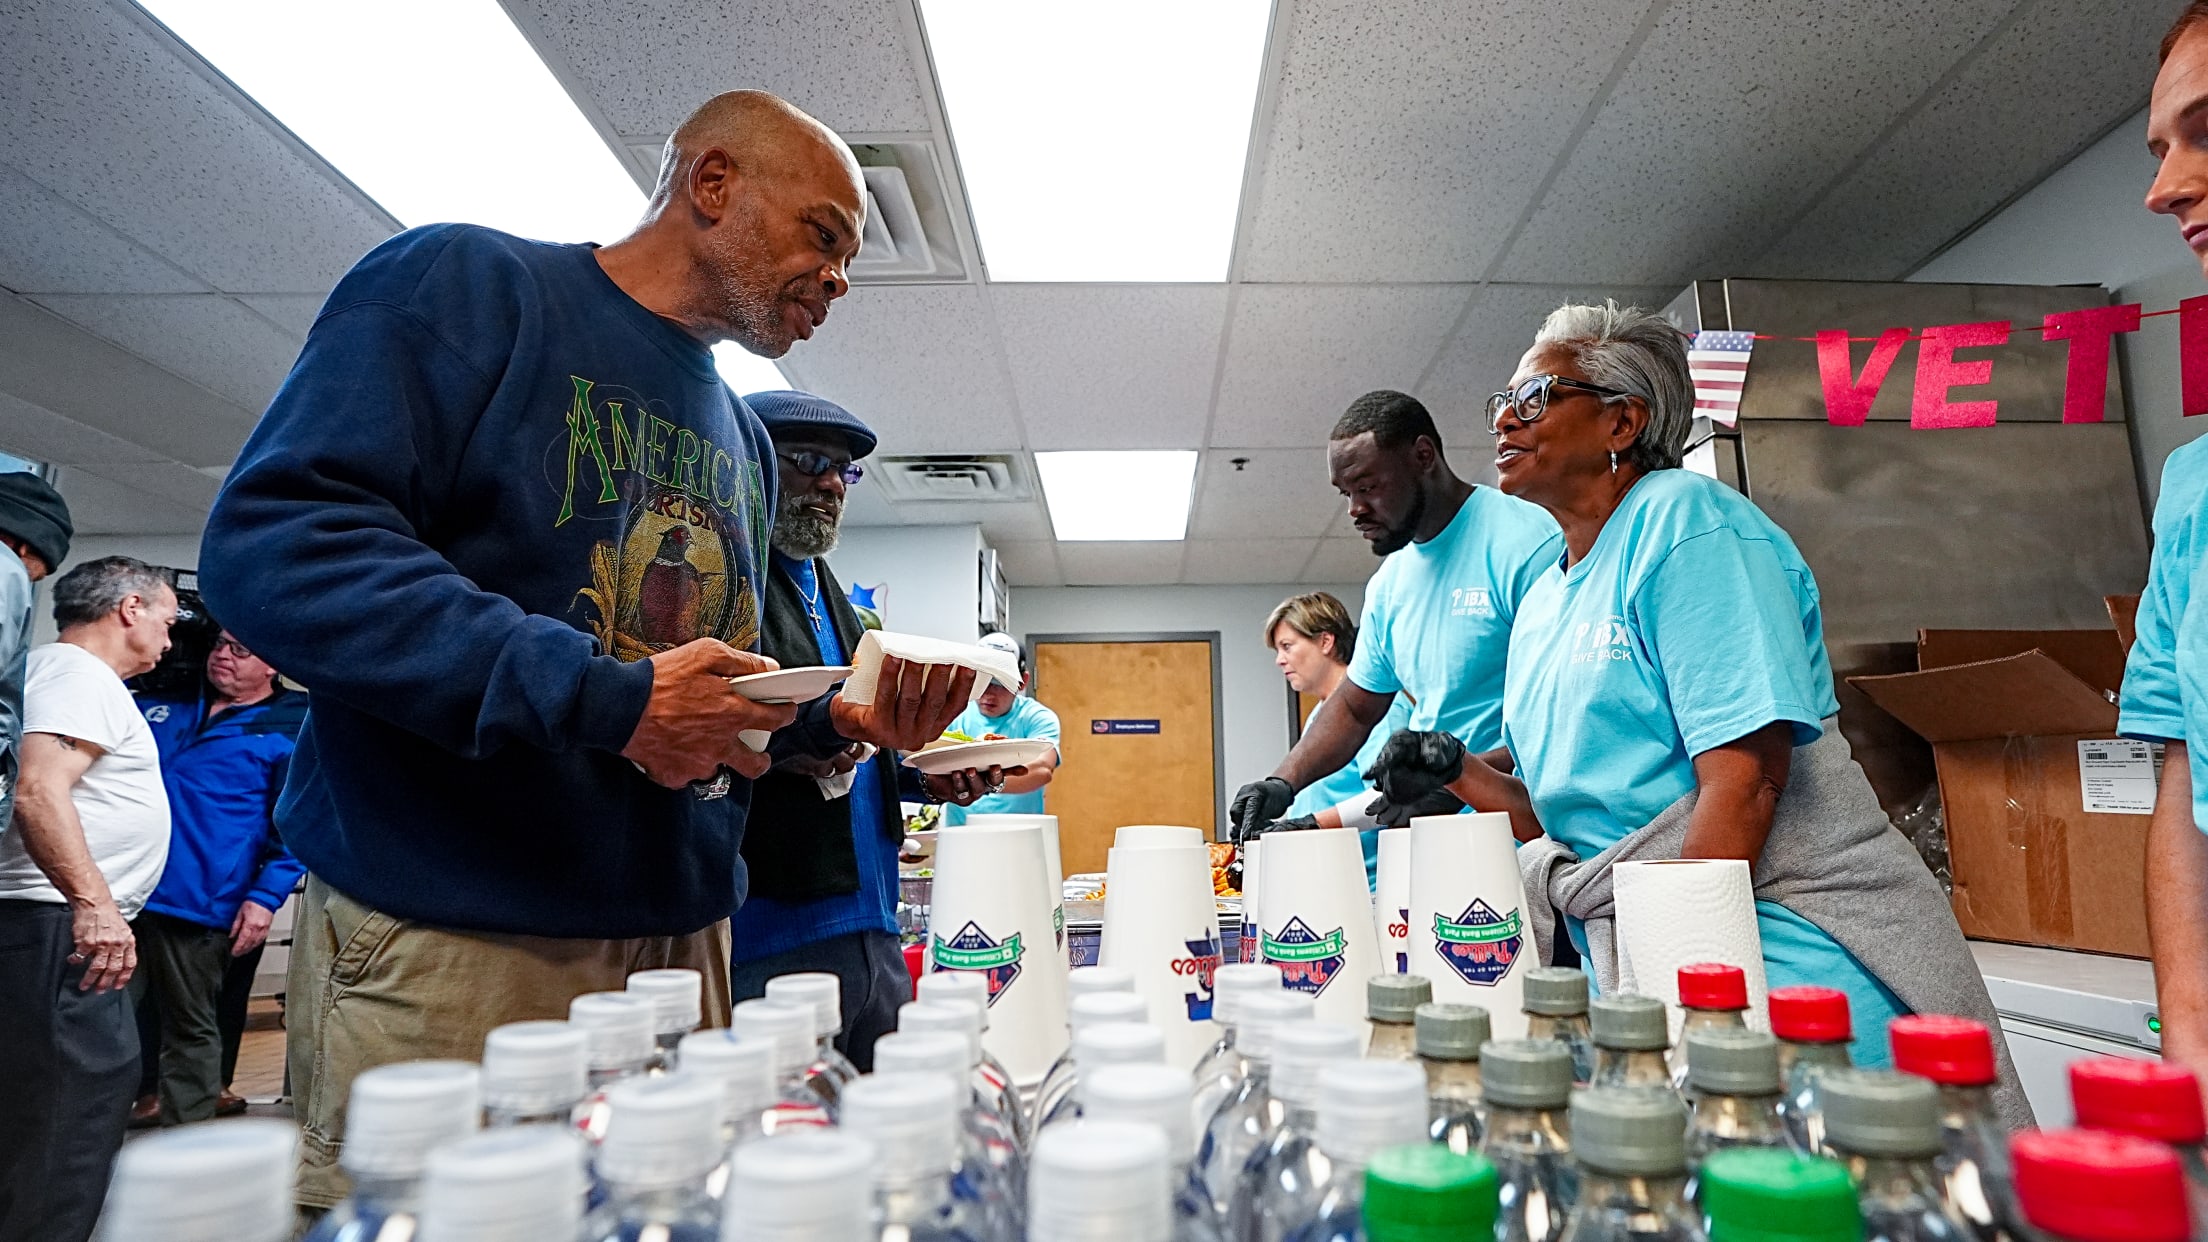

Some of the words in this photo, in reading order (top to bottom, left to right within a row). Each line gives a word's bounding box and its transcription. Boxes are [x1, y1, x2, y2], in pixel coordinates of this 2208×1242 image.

[1816, 292, 2208, 430] VET
[1463, 591, 1489, 607] IBX
[1592, 622, 1631, 649] IBX
[1572, 651, 1595, 664] GIVE
[1597, 648, 1633, 662] BACK
[1444, 928, 1460, 937] Park
[1460, 929, 1481, 938] Bank
[1480, 926, 1508, 937] Citizens
[1279, 948, 1296, 956] Bank
[1296, 945, 1326, 955] Citizens
[1451, 942, 1513, 965] Phillies
[951, 955, 970, 964] Bank
[970, 952, 1002, 963] Citizens
[1271, 961, 1328, 985] Philli
